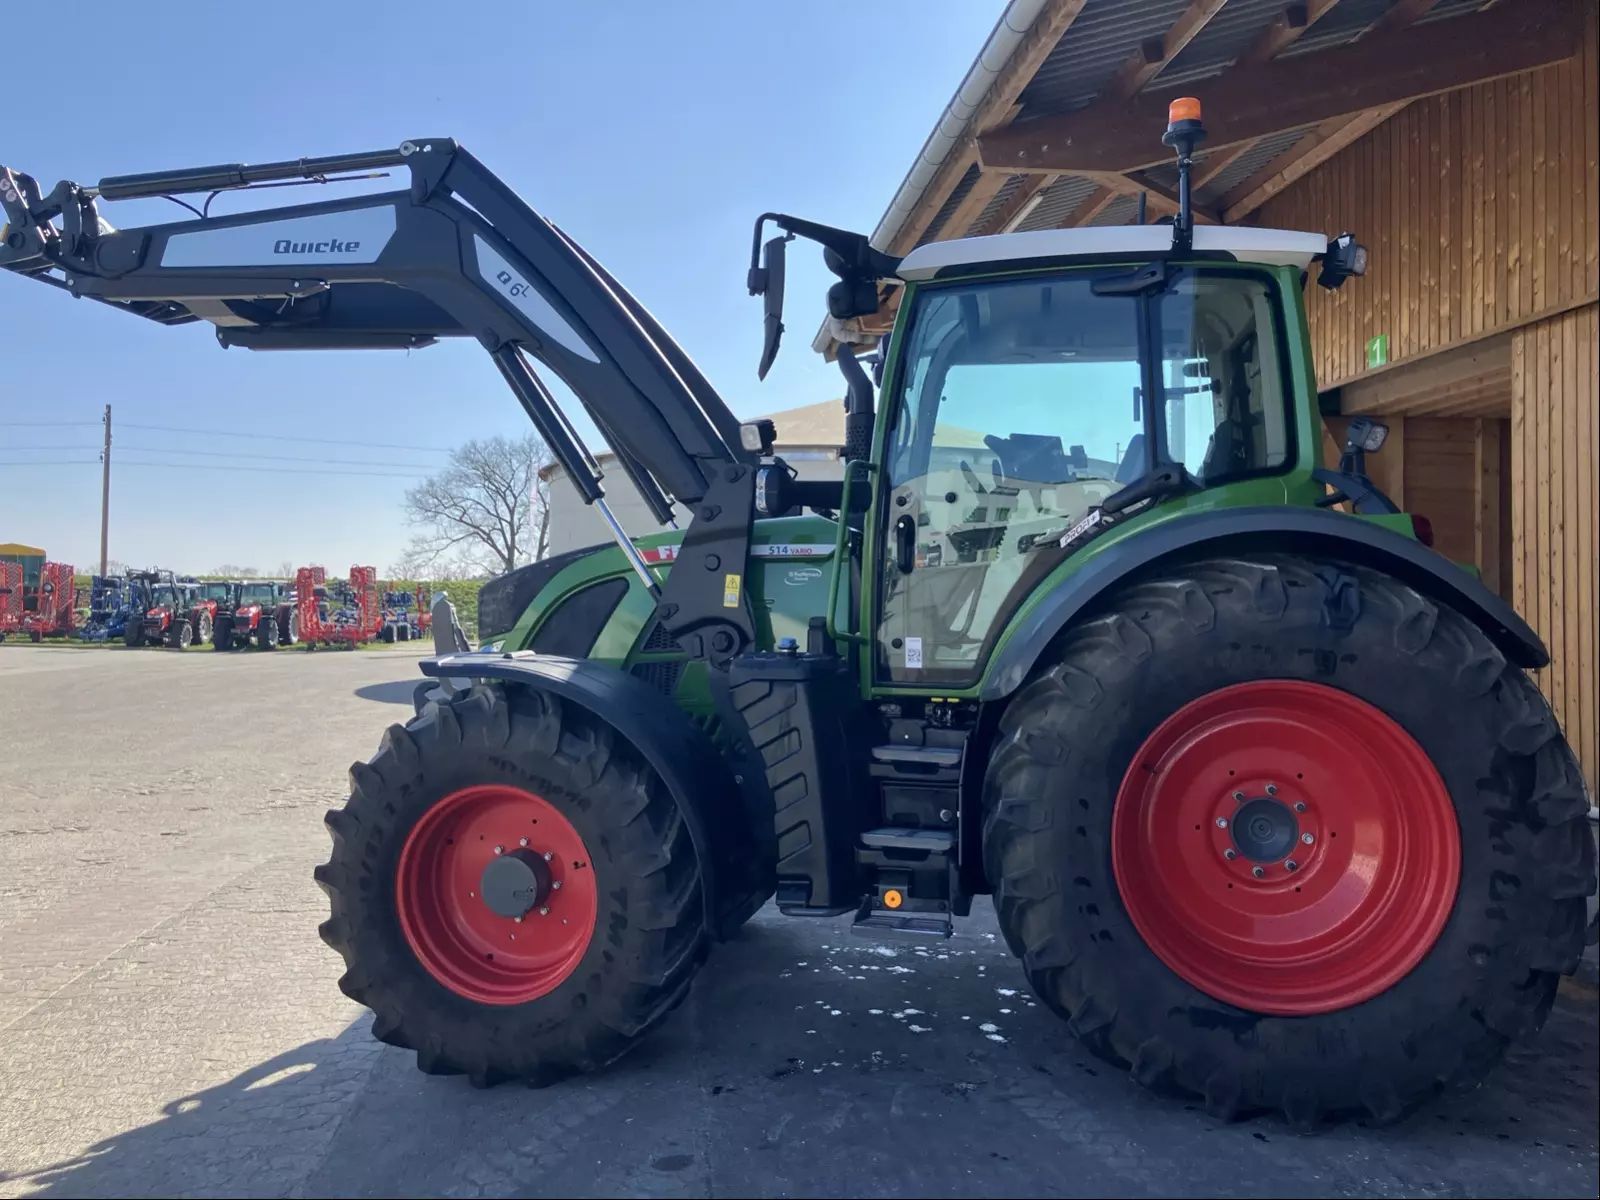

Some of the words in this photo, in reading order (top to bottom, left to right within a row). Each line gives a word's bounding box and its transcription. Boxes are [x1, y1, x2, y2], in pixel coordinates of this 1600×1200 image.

[274, 239, 360, 253] Quicke
[1372, 338, 1380, 366] 1
[769, 545, 788, 554] 514
